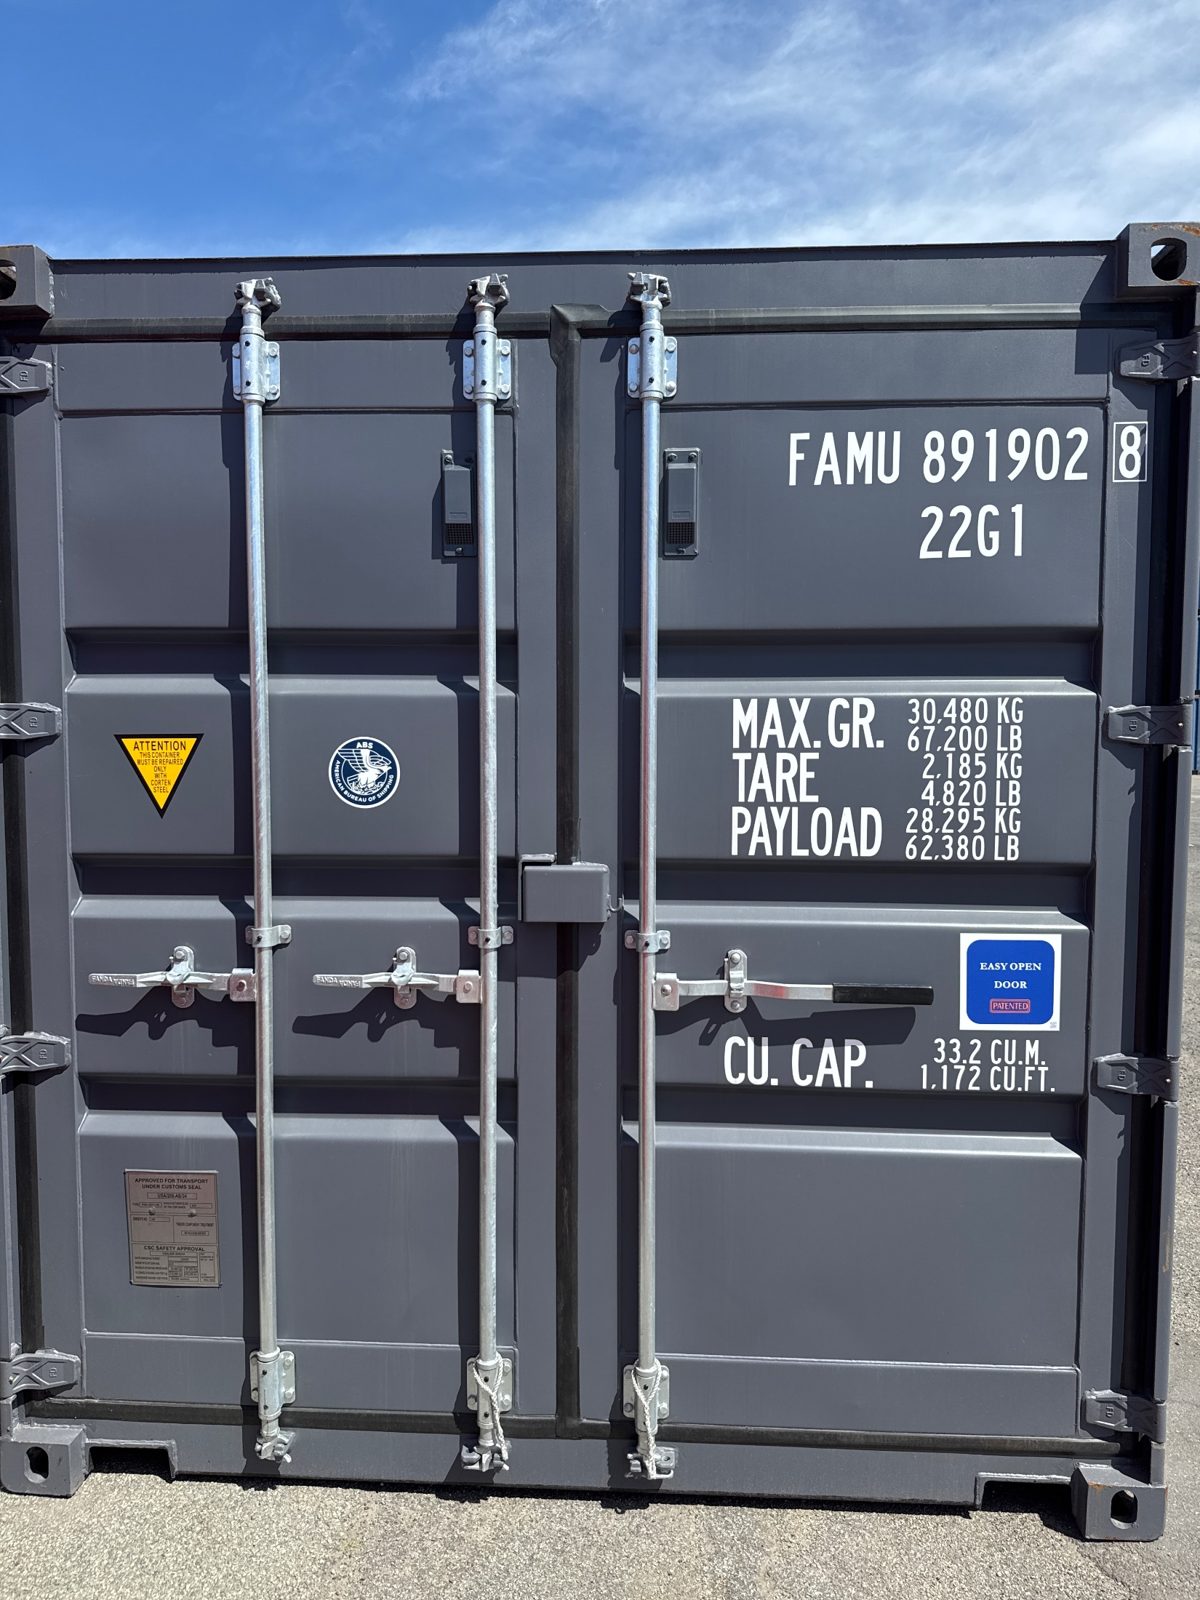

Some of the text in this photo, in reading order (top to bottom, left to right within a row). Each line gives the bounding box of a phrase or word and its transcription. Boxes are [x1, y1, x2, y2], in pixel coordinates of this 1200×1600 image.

[789, 427, 1141, 486] FAMU 891902 8
[919, 504, 1023, 559] 22G1
[908, 697, 1023, 724] 30,480 KG
[133, 740, 187, 751] ATTENTION
[356, 741, 374, 749] ABS
[907, 725, 1022, 751] 67,200 LB
[733, 752, 819, 803] TARE
[923, 753, 1022, 779] 2,185 KG
[334, 760, 345, 791] AMERICAN
[343, 790, 367, 802] BUREAU
[377, 774, 394, 799] SHIPPING
[921, 780, 1021, 807] 4,820 LB
[732, 806, 883, 857] PAYLOAD
[906, 808, 1021, 834] 28,295 KG
[905, 835, 1020, 861] 62,380 LB
[980, 962, 1042, 971] EASY OPEN
[994, 980, 1027, 989] DOOR
[992, 1002, 1029, 1010] PATENTED
[724, 1036, 874, 1088] CU. CAP.
[934, 1038, 1046, 1065] 33.2 CU.M.
[920, 1064, 1056, 1092] 1,172 CU.FT.
